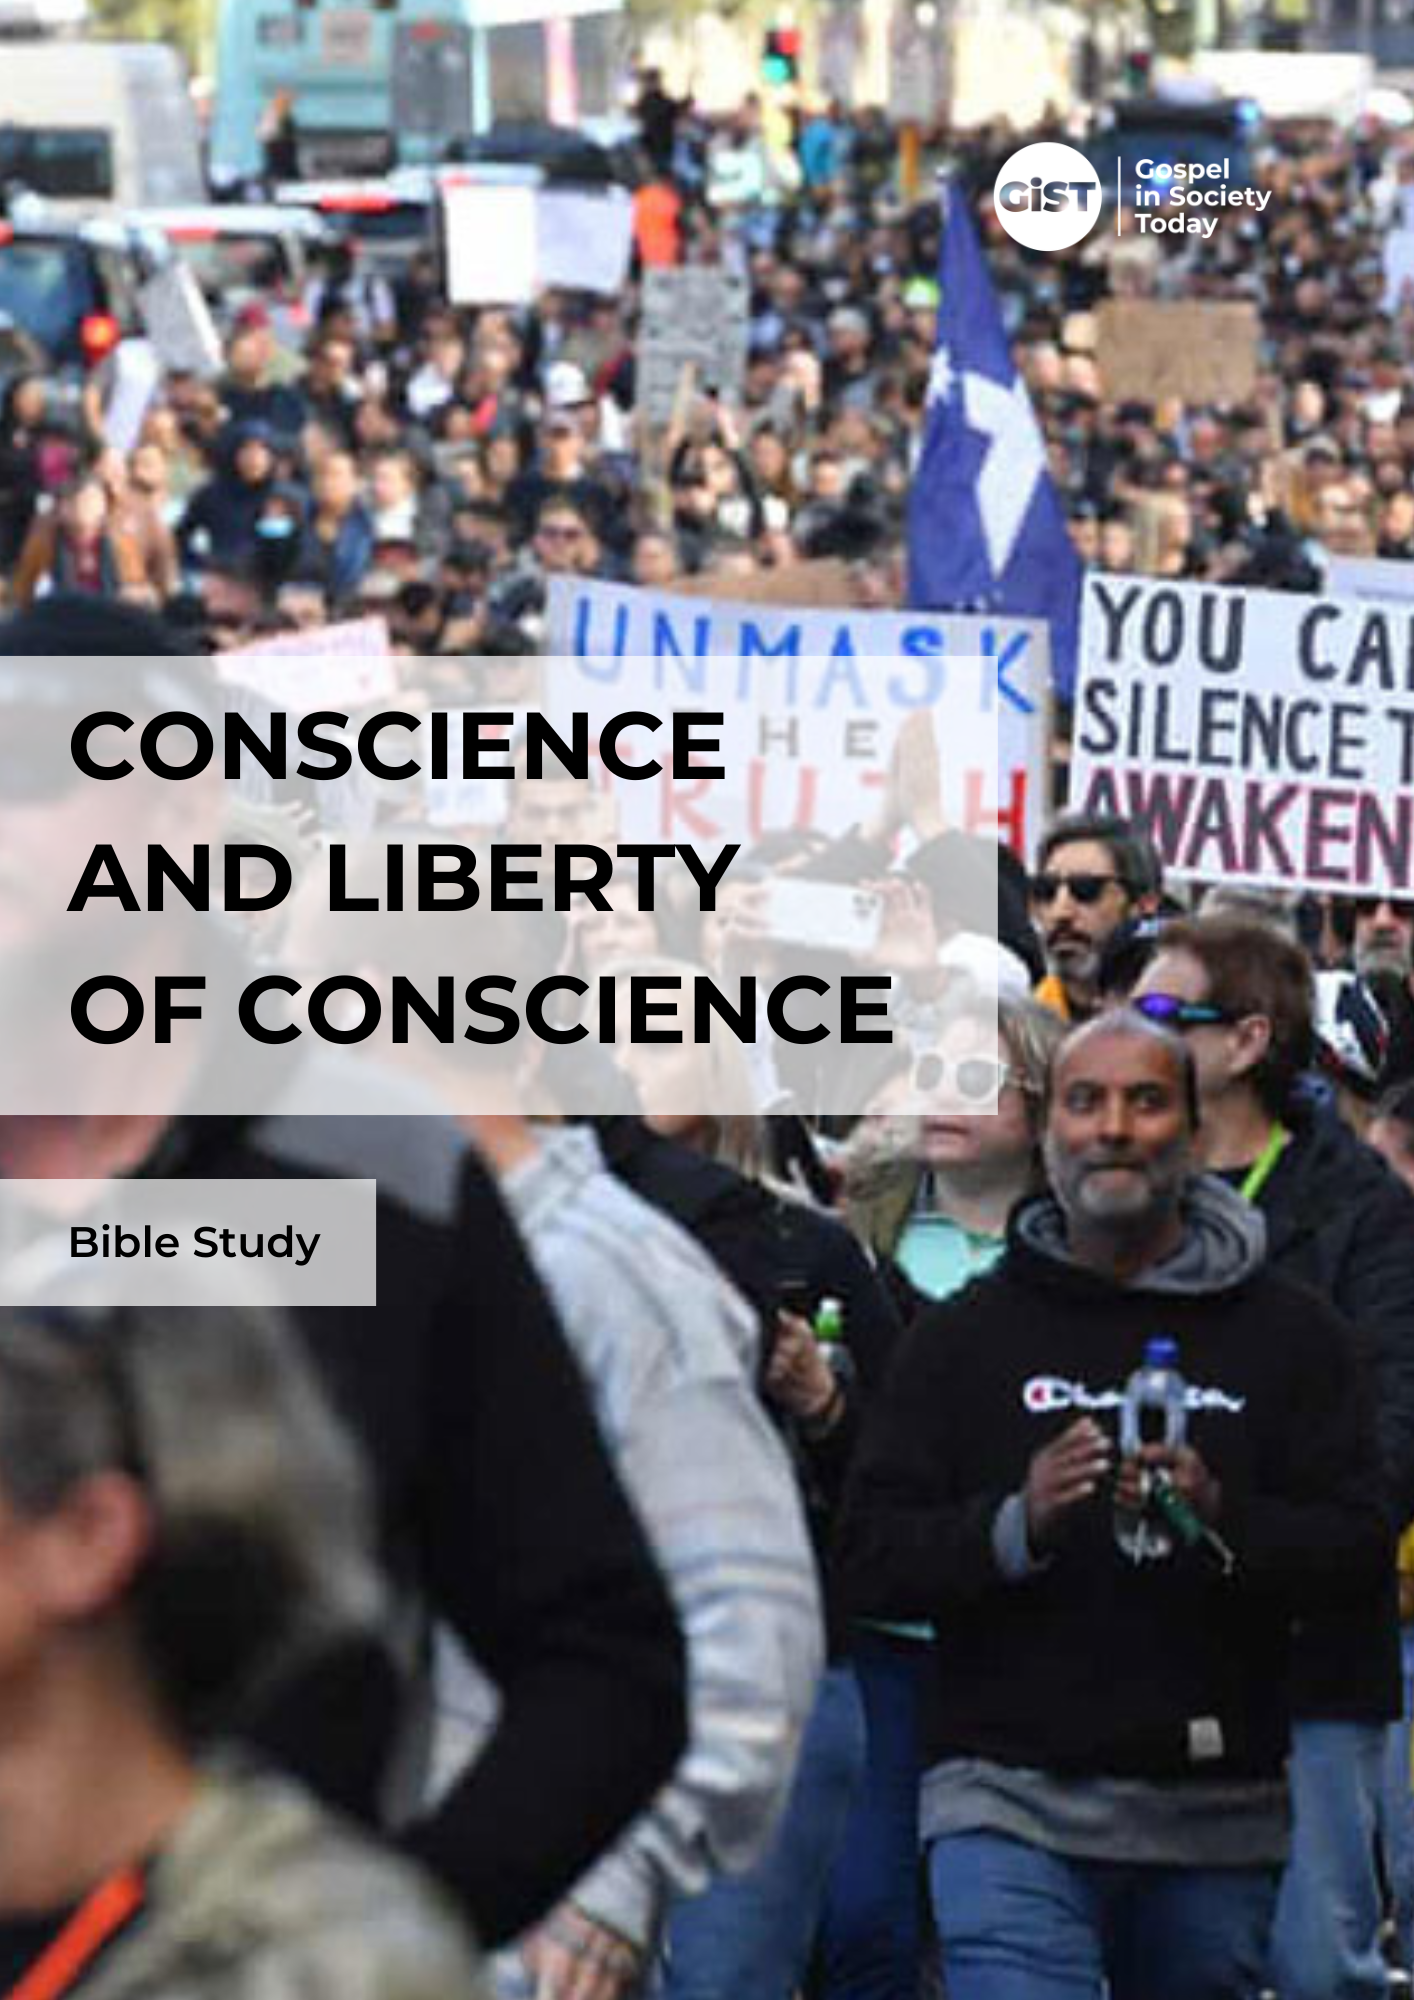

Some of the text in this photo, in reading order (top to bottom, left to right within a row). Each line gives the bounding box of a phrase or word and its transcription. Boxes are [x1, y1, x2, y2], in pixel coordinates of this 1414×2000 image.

[571, 597, 1036, 714] UNMASK
[1091, 581, 1246, 673] YOU
[1080, 678, 1368, 779] SILENCE
